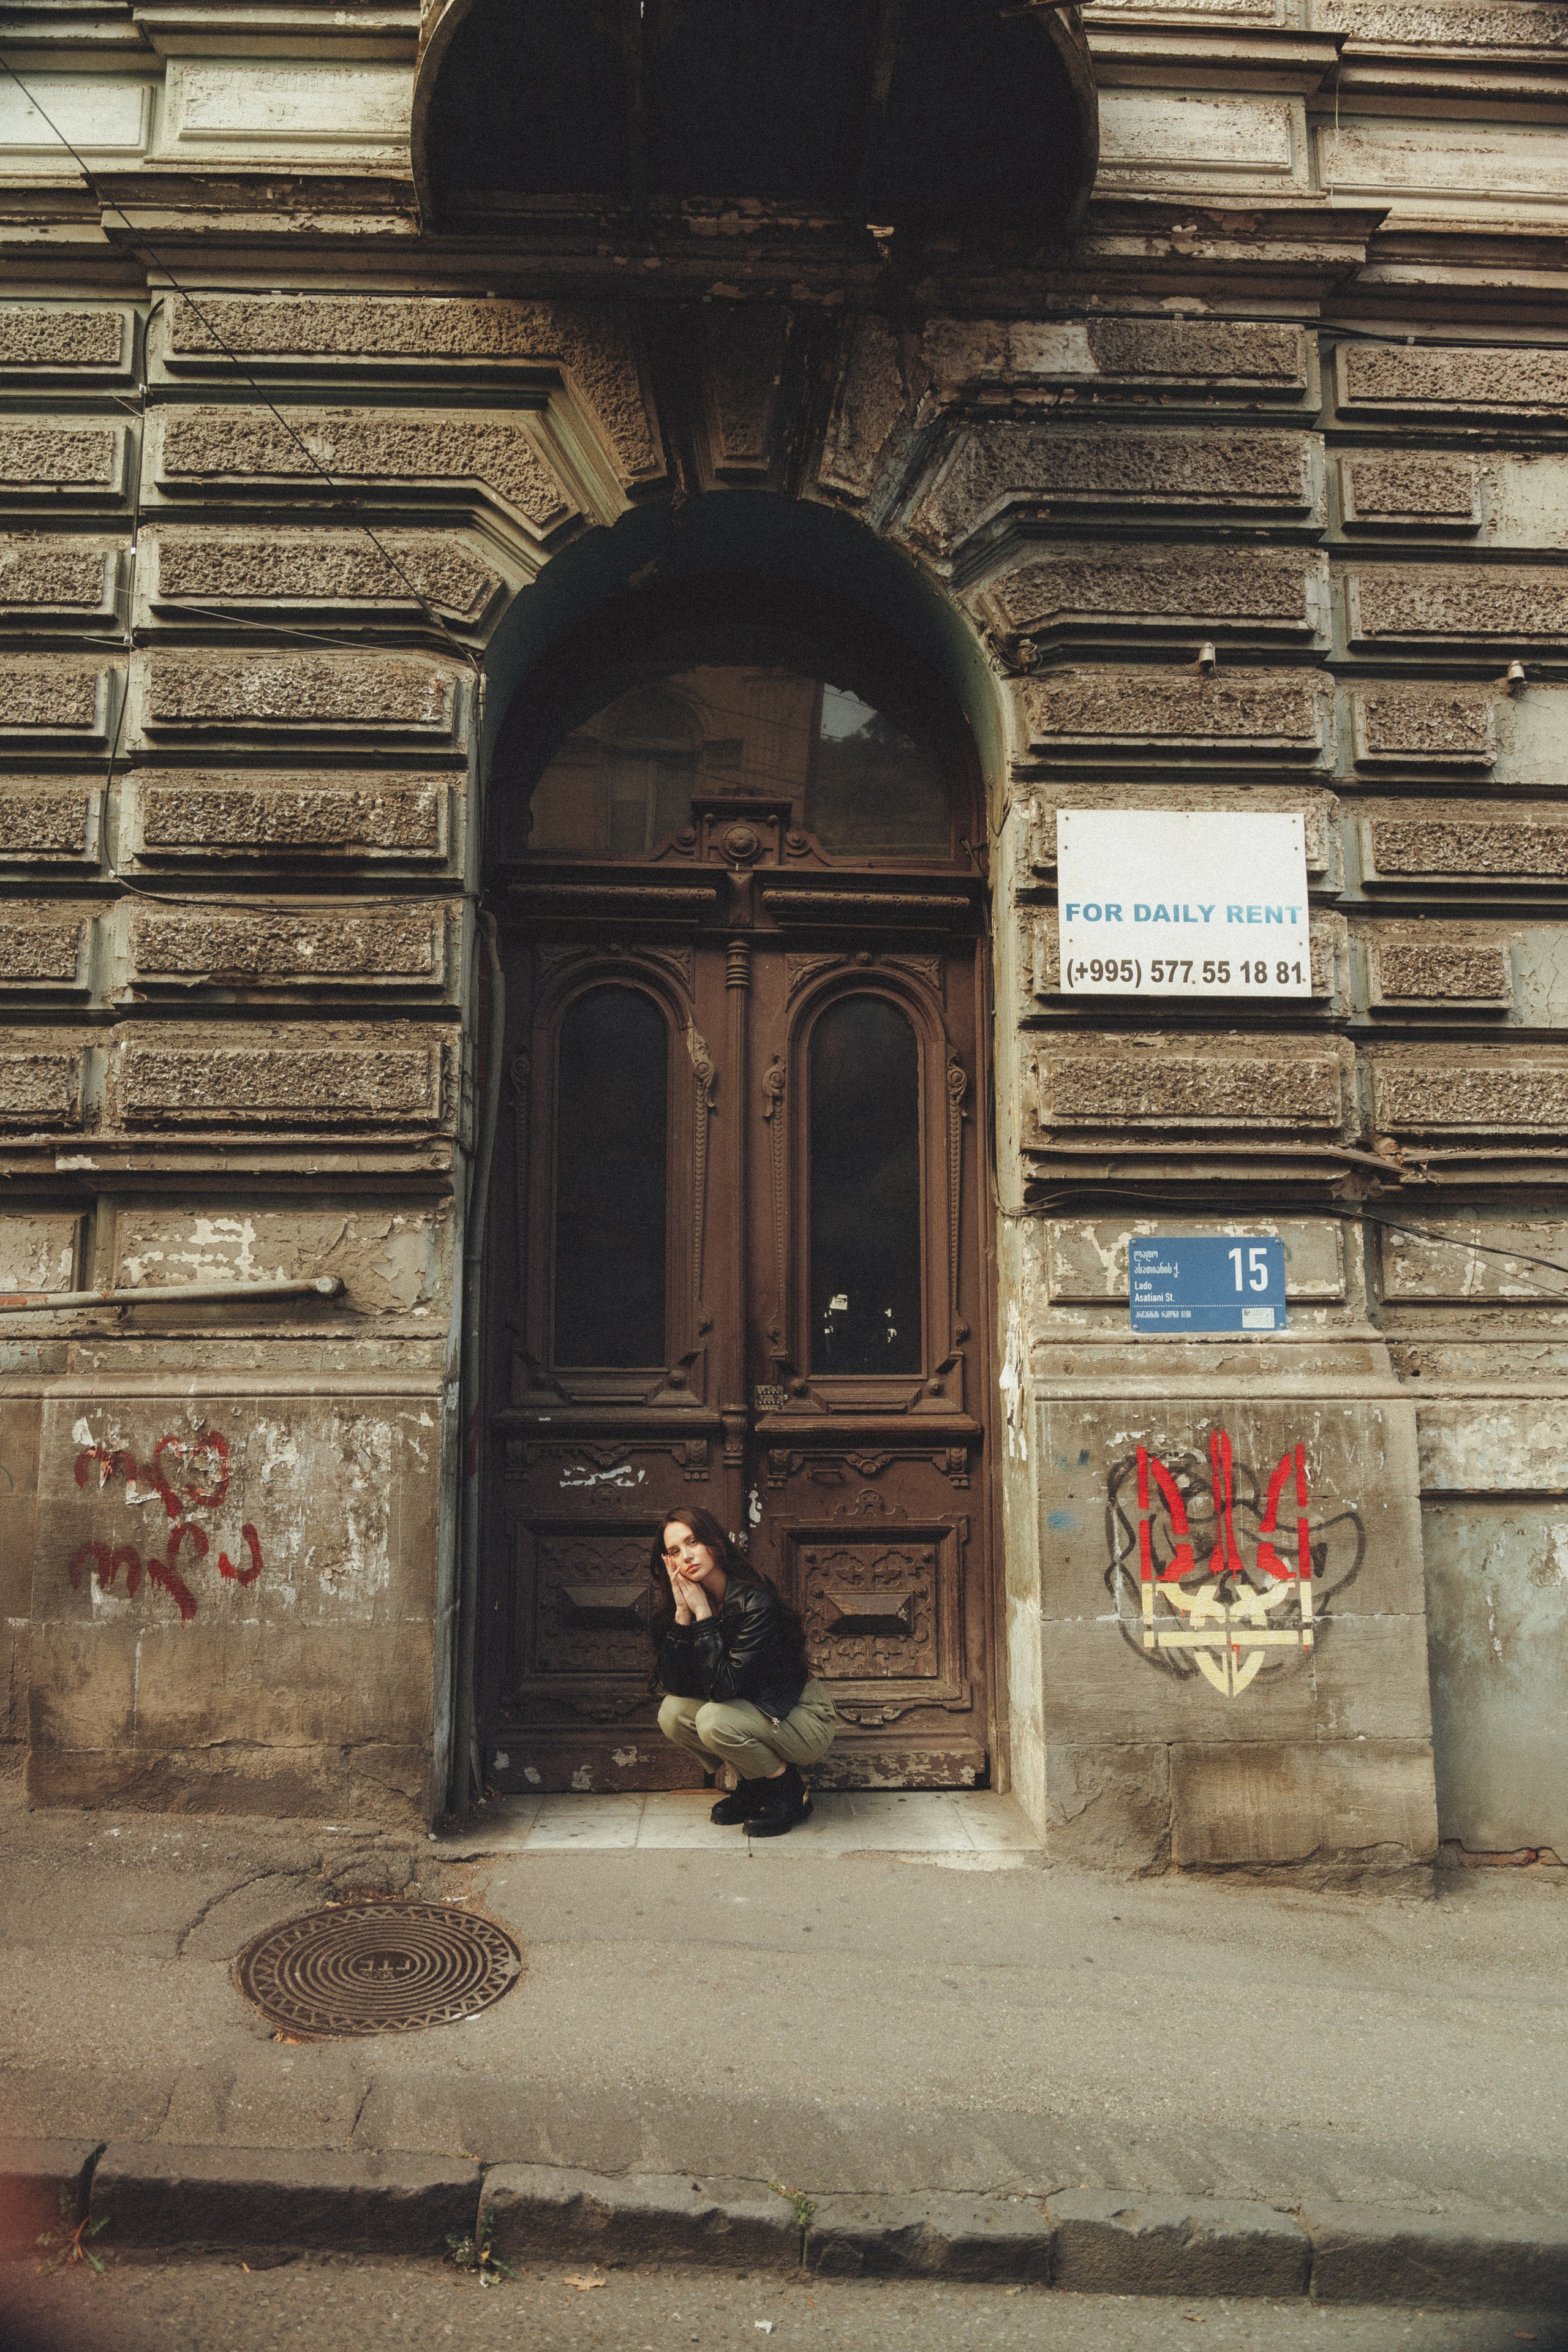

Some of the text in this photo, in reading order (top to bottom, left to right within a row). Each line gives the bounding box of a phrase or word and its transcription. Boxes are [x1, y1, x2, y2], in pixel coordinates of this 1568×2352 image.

[1066, 903, 1302, 924] FOR DAILY RENT
[1066, 959, 1302, 988] (+995) 577 55 18 81
[1134, 1250, 1158, 1262] ლადო
[1134, 1262, 1172, 1274] ასათიანის
[1229, 1248, 1268, 1291] 15
[1134, 1281, 1152, 1290] Lado
[1134, 1293, 1175, 1302] Asatiani St.
